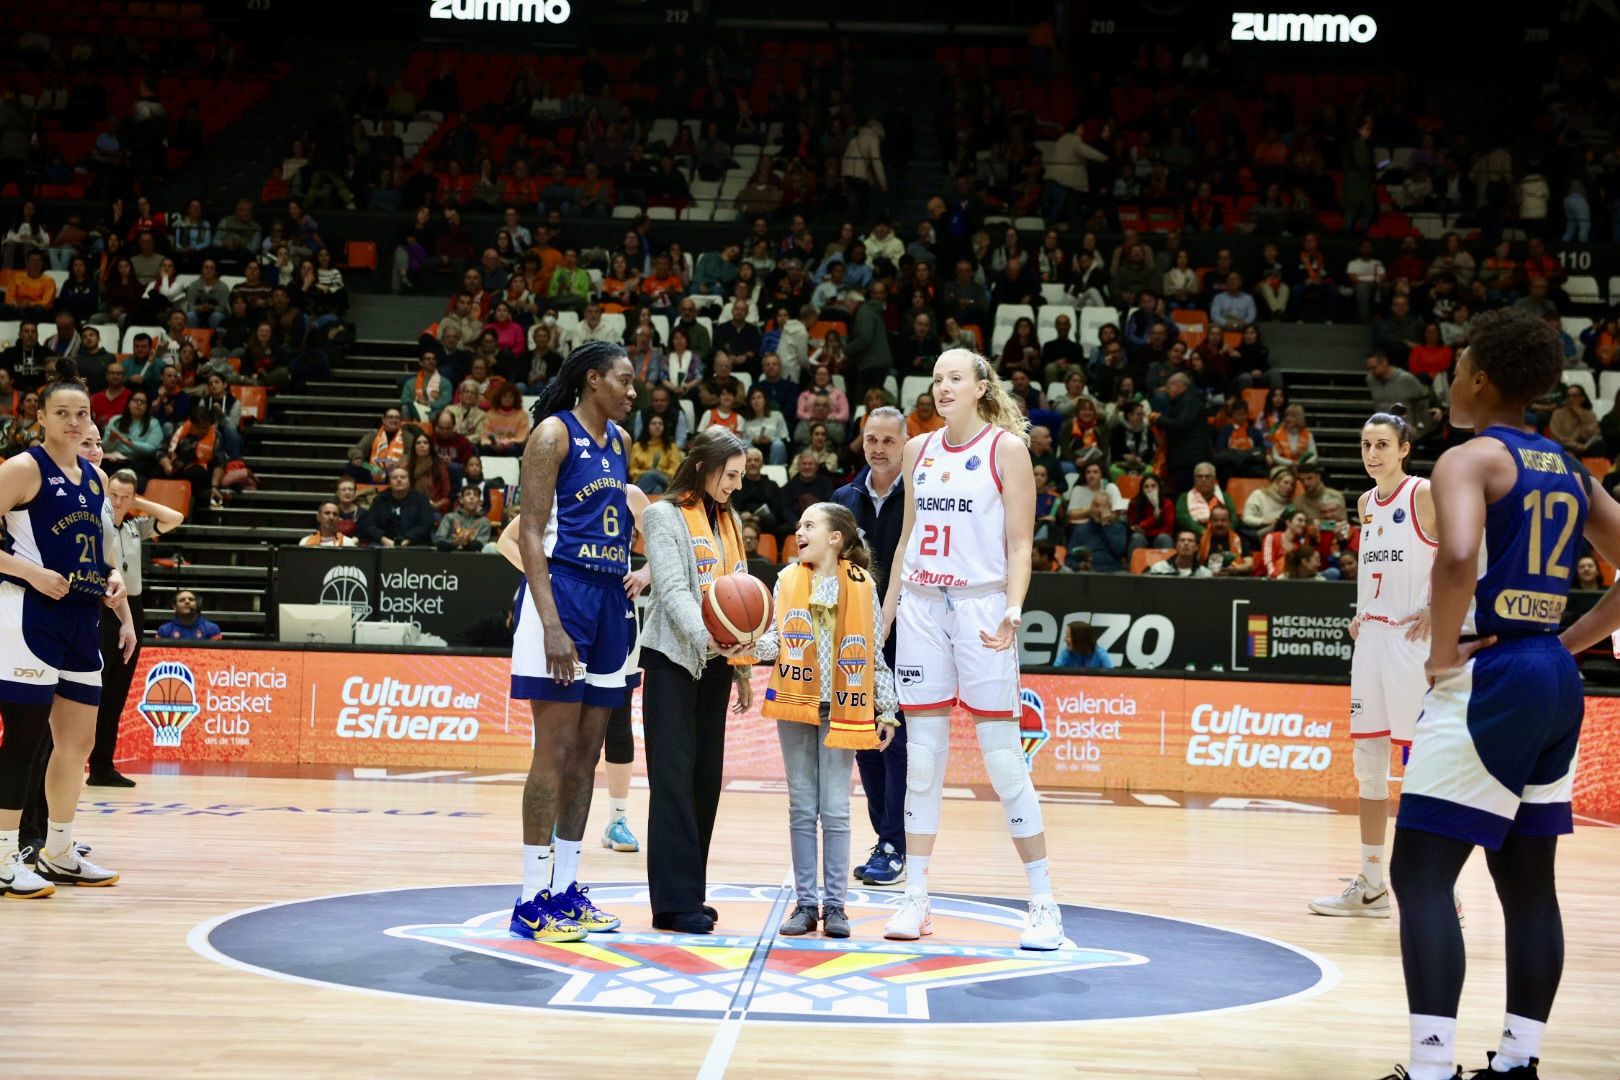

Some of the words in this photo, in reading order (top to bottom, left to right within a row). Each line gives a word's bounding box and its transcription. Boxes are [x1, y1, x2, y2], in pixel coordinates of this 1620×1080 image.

[430, 0, 571, 24] zummo
[665, 9, 689, 24] 212
[1089, 19, 1116, 35] 210
[1231, 12, 1378, 43] zummo
[1557, 250, 1591, 270] 110
[916, 497, 955, 512] ALENCIA
[958, 499, 974, 513] BC
[603, 505, 620, 537] 6
[920, 525, 951, 557] 21
[1524, 489, 1579, 579] 12
[75, 533, 97, 564] 21
[1391, 550, 1404, 562] BC
[380, 567, 459, 591] valencia
[1372, 573, 1382, 599] 7
[380, 590, 444, 615] basket
[1272, 615, 1351, 628] MECENAZGO
[1272, 627, 1344, 640] DEPORTIVO
[1271, 640, 1311, 658] Juan
[1312, 641, 1352, 661] Roig
[14, 668, 45, 679] DSV
[207, 665, 287, 689] valencia
[778, 663, 813, 682] VBC
[206, 689, 272, 713] basket
[342, 675, 453, 708] Cultura
[453, 692, 480, 709] del
[836, 691, 868, 707] VBC
[1056, 691, 1137, 716] valencia
[203, 713, 250, 735] club
[336, 706, 481, 741] Esfuerzo
[1055, 715, 1122, 740] basket
[1191, 704, 1304, 737] Cultura
[1304, 721, 1333, 738] del
[1055, 738, 1101, 761] club
[1186, 735, 1333, 771] Esfuerzo
